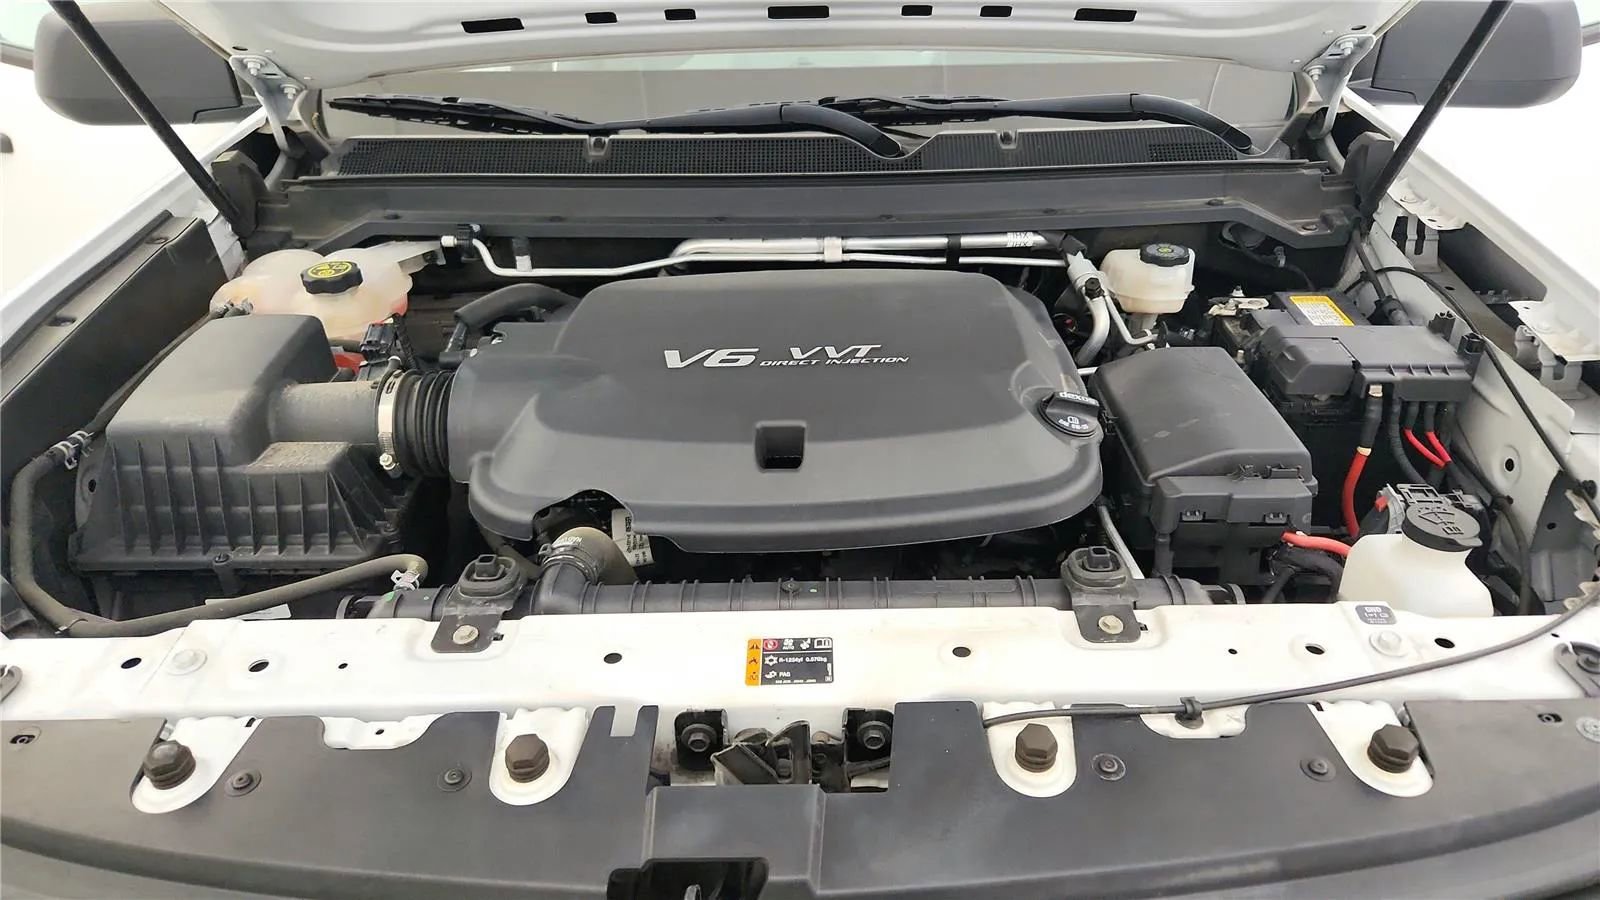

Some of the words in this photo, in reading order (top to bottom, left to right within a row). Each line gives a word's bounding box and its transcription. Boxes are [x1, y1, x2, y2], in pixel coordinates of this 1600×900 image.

[663, 347, 760, 369] V6
[790, 344, 882, 360] VVT
[759, 359, 821, 367] DIRECT
[825, 357, 910, 366] INJECTION
